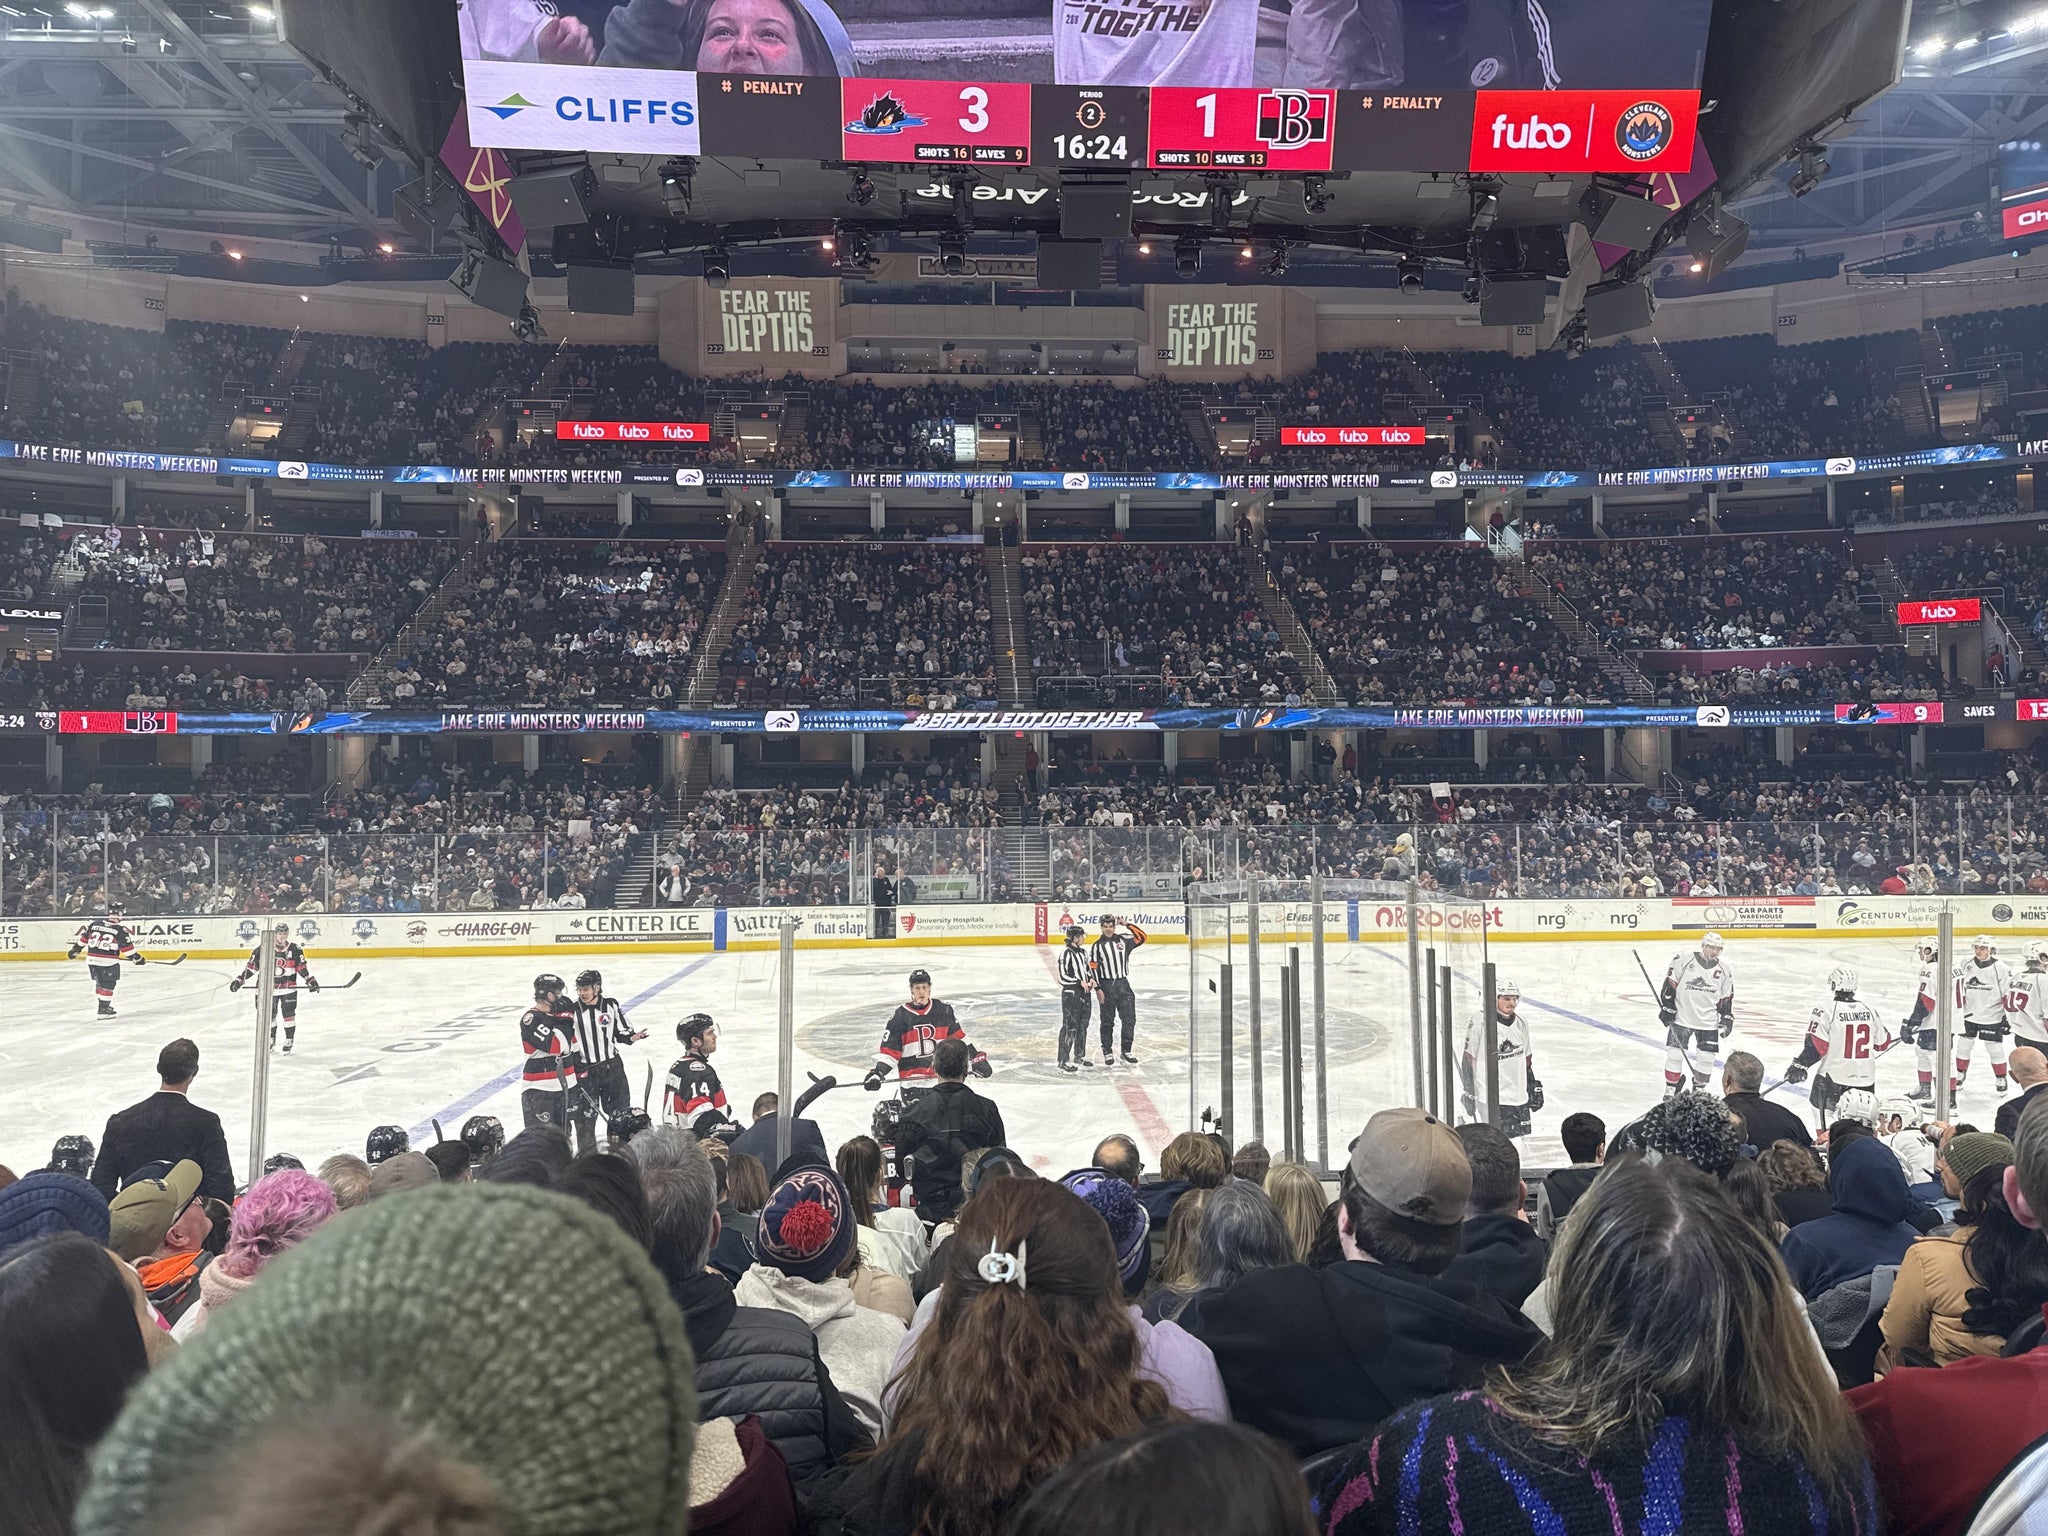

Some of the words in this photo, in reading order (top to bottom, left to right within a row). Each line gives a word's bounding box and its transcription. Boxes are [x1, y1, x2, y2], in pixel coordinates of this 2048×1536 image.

[1081, 4, 1200, 38] TOGETHE
[721, 80, 732, 92] #
[743, 81, 803, 95] PENALTY
[555, 95, 695, 126] CLIFFS
[958, 87, 989, 133] 3
[1362, 97, 1373, 109] #
[1383, 97, 1443, 109] PENALTY
[1087, 109, 1095, 120] 2
[1196, 94, 1217, 138] 1
[1624, 104, 1668, 121] CLEVELAND
[1492, 114, 1572, 149] fubo
[918, 147, 950, 158] SHOTS
[953, 148, 967, 159] 16
[976, 149, 1005, 160] SAVES
[1015, 149, 1023, 160] 9
[1053, 134, 1128, 160] 16:24
[1621, 143, 1662, 160] MONSTERS
[1159, 153, 1190, 163] SHOTS
[1195, 153, 1209, 164] 10
[1215, 154, 1245, 164] SAVES
[1250, 154, 1264, 165] 13
[146, 300, 163, 310] 220
[720, 290, 769, 313] FEAR
[774, 291, 812, 312] THE
[428, 316, 443, 324] 221
[1168, 304, 1215, 327] FEAR
[1222, 303, 1258, 324] THE
[722, 312, 814, 352] DEPTHS
[708, 345, 724, 353] 222
[813, 347, 828, 355] 223
[1167, 324, 1257, 366] DEPTHS
[1259, 350, 1274, 358] 225
[573, 423, 605, 438] fubo
[618, 424, 650, 439] fubo
[662, 425, 694, 440] fubo
[1296, 429, 1327, 443] fubo
[1339, 429, 1369, 443] fubo
[1381, 429, 1411, 443] fubo
[2017, 440, 2048, 456] LAKE
[14, 443, 48, 461] LAKE
[52, 446, 82, 464] ERIE
[86, 450, 155, 470] MONSTERS
[159, 455, 218, 474] WEEKEND
[230, 465, 262, 475] PRESENTED
[311, 466, 352, 475] CLEVELAND
[451, 468, 478, 484] LAKE
[482, 468, 506, 484] ERIE
[509, 469, 568, 484] MONSTERS
[571, 469, 622, 484] WEEKEND
[1598, 471, 1624, 486] LAKE
[1627, 469, 1651, 485] ERIE
[1653, 467, 1713, 484] MONSTERS
[1717, 464, 1769, 482] WEEKEND
[850, 472, 876, 488] LAKE
[879, 473, 902, 488] ERIE
[905, 473, 962, 488] MONSTERS
[965, 473, 1013, 488] WEEKEND
[1220, 473, 1245, 489] LAKE
[1248, 473, 1270, 489] ERIE
[1273, 473, 1329, 489] MONSTERS
[1331, 473, 1379, 488] WEEKEND
[0, 608, 62, 619] LEXUS
[1921, 605, 1956, 618] fubo
[1395, 710, 1423, 725] LAKE
[1428, 709, 1453, 725] ERIE
[1458, 709, 1522, 724] MONSTERS
[1528, 708, 1584, 724] WEEKEND
[1646, 714, 1678, 722] PRESENTED
[1680, 714, 1688, 722] BY
[1734, 709, 1781, 717] CLEVELAND
[1744, 715, 1781, 723] NATURAL
[1915, 706, 1928, 721] 9
[1963, 706, 1995, 717] SAVES
[80, 716, 88, 729] 1
[442, 714, 472, 730] LAKE
[478, 713, 506, 730] ERIE
[511, 713, 580, 729] MONSTERS
[585, 713, 645, 729] WEEKEND
[585, 915, 662, 932] CENTER
[670, 915, 699, 931] ICE
[917, 917, 951, 925] University
[953, 916, 984, 924] Hospitals
[1537, 914, 1566, 929] nrg
[1610, 912, 1638, 928] nrg
[298, 927, 319, 935] NATION
[354, 927, 376, 935] NATION
[454, 922, 507, 936] CHARGE
[814, 921, 835, 935] that
[89, 931, 114, 950] 32
[147, 938, 168, 946] Jeep
[1839, 1011, 1871, 1022] SILLINGER
[533, 1024, 551, 1042] 16
[1808, 1020, 1819, 1034] 12
[1844, 1023, 1870, 1059] 12
[690, 1082, 711, 1098] 14
